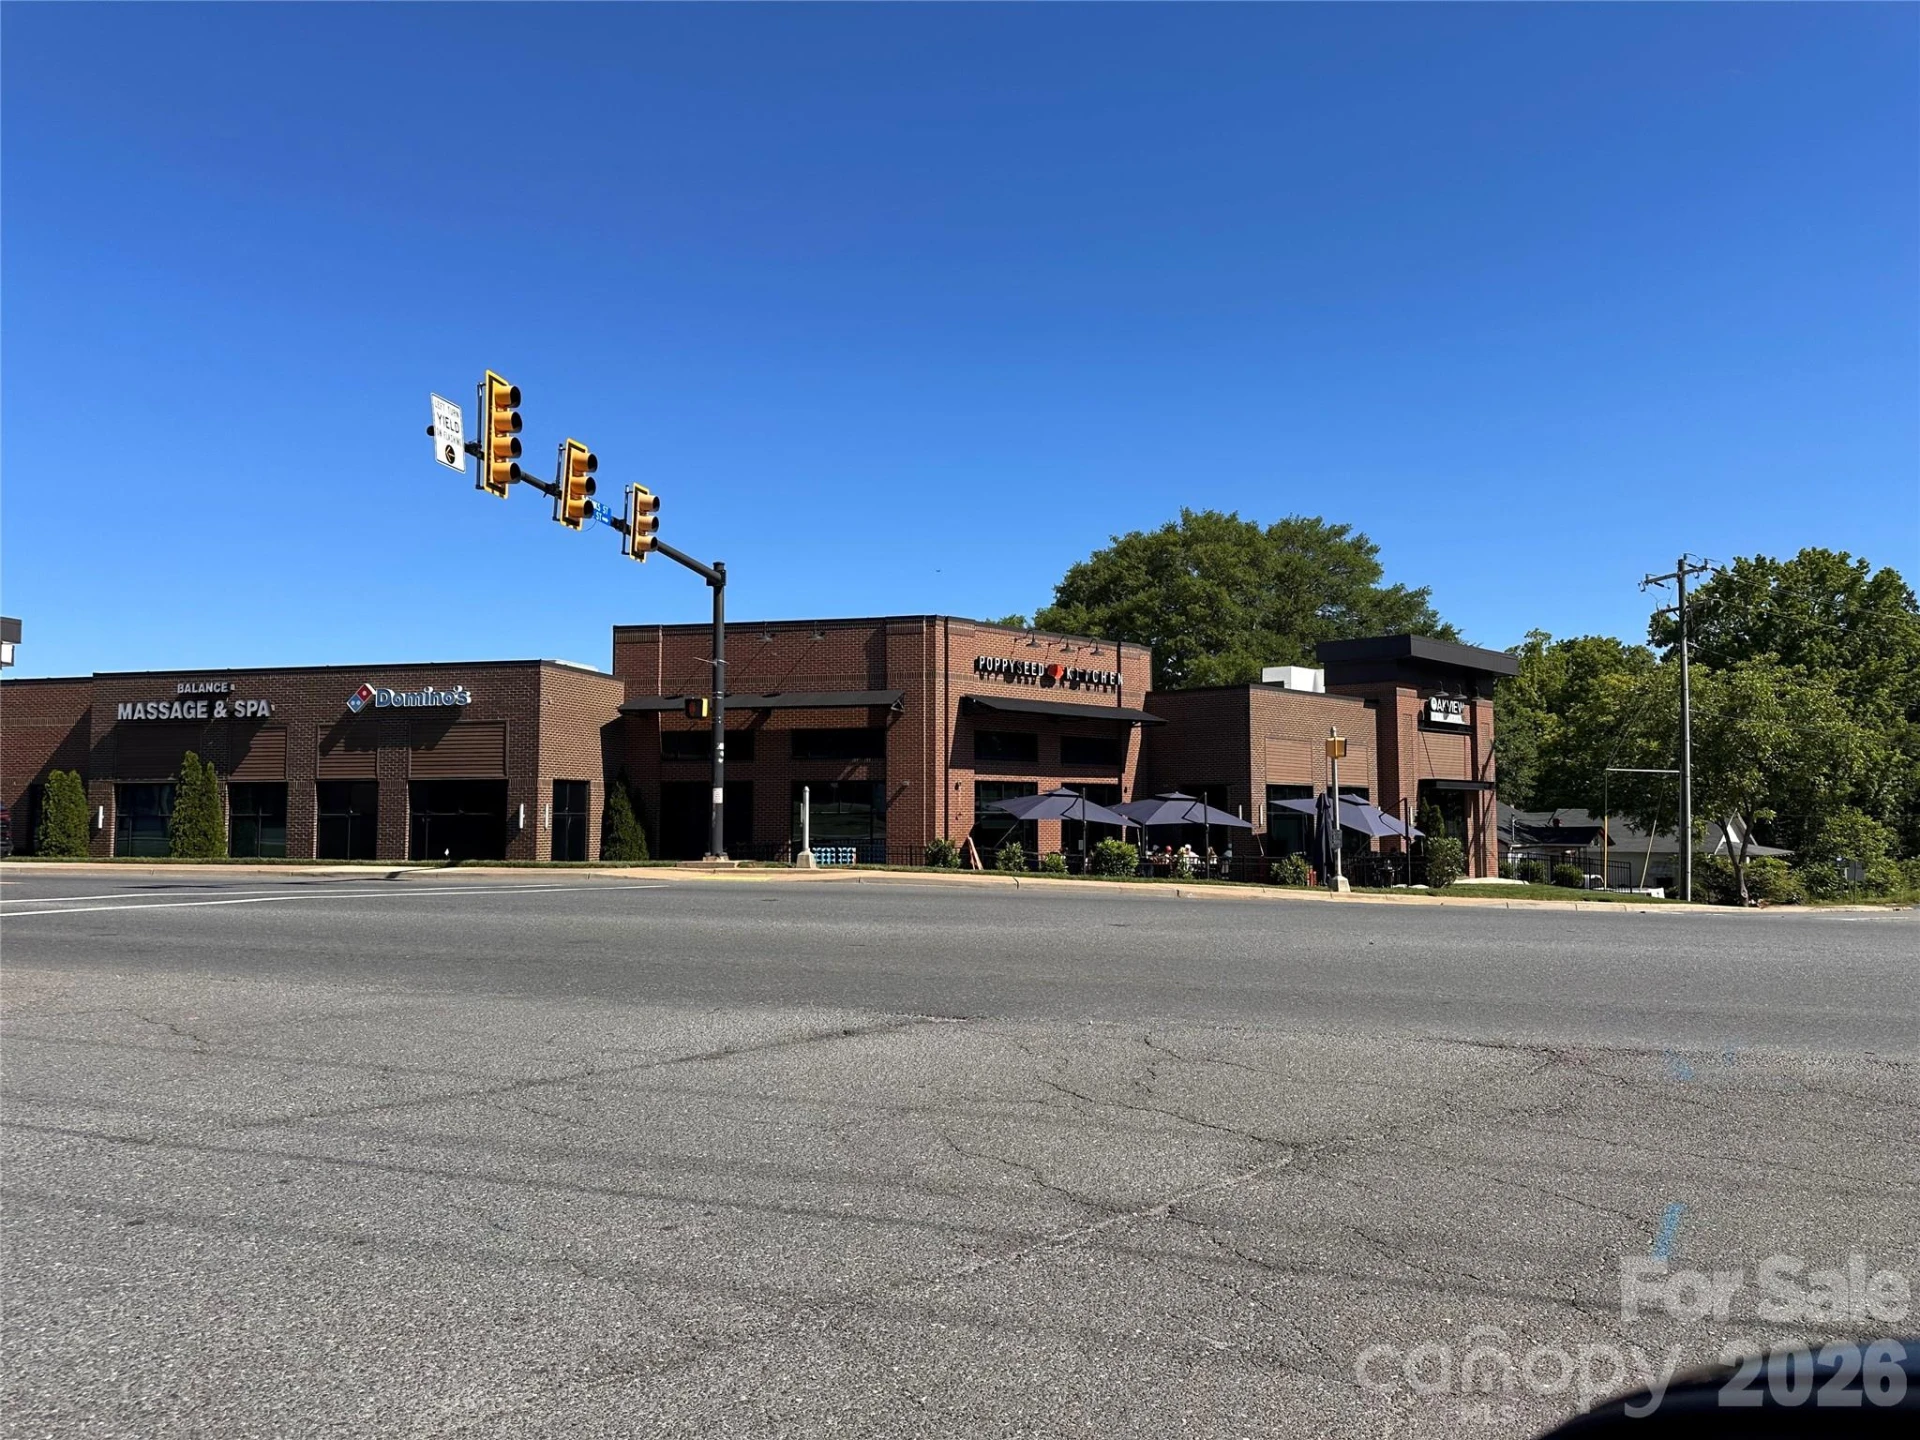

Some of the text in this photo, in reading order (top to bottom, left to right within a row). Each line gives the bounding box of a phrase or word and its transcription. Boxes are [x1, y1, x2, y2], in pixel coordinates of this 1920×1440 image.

[437, 412, 460, 433] YIELD
[979, 655, 1124, 686] POPPYSEED KITCHEN
[177, 681, 229, 694] BALANCE
[375, 685, 472, 708] Domino's
[117, 699, 271, 720] MASSAGE & SPA
